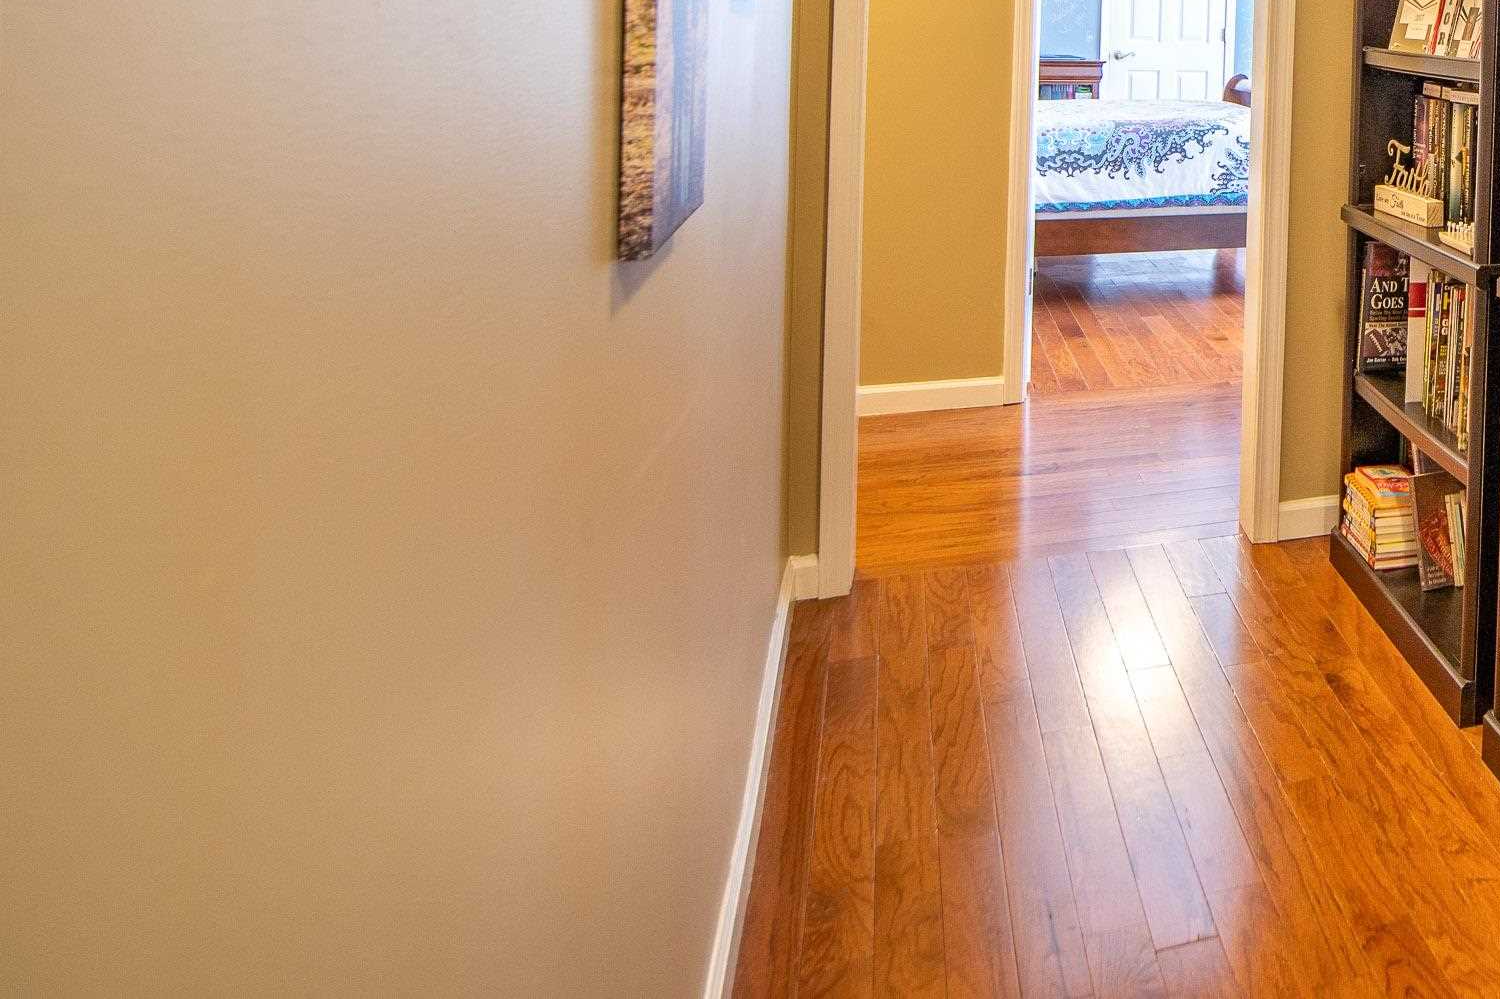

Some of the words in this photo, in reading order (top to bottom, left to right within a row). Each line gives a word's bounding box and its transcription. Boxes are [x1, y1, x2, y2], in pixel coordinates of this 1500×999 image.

[1384, 139, 1431, 197] Faith
[1370, 277, 1398, 293] AND
[1370, 294, 1404, 309] GOES
